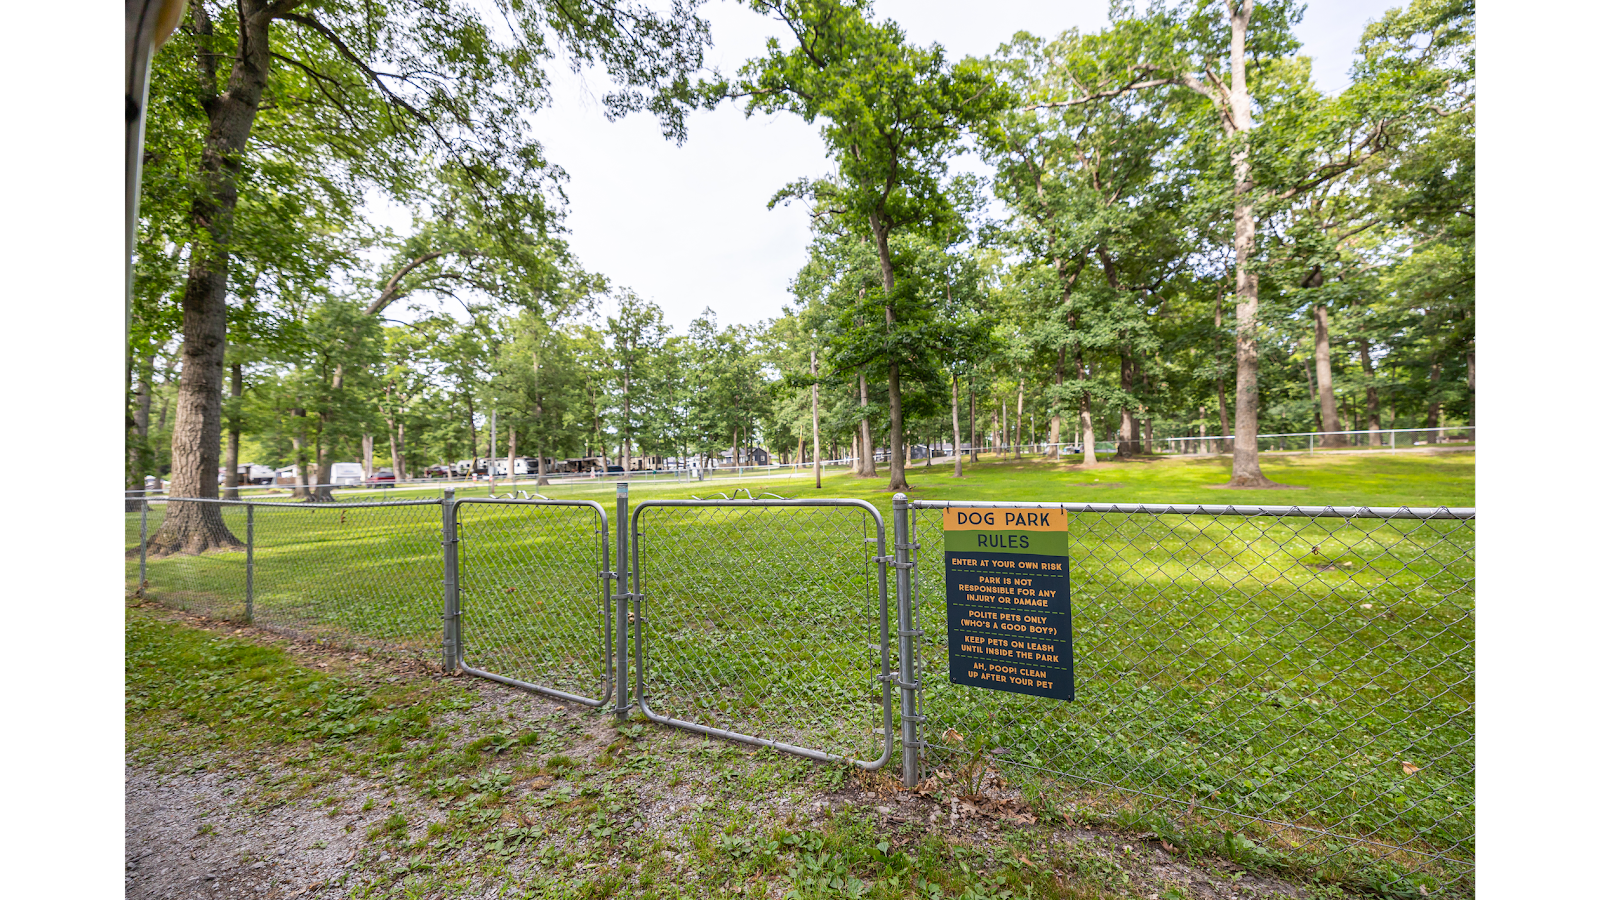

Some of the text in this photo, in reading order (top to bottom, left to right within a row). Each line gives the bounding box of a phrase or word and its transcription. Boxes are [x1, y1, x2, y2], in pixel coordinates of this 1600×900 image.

[958, 512, 1050, 526] DOG PARK
[977, 534, 1030, 549] RULES
[952, 558, 978, 566] ENTER
[992, 560, 1015, 568] YOUR
[1018, 561, 1038, 569] OWN
[1041, 562, 1062, 570] RISK
[979, 576, 1000, 584] PARK
[1014, 578, 1032, 586] NOT
[959, 584, 1056, 598] RESPONSIBLE FOR ANY
[966, 594, 1048, 607] INJURY OR DAMAGE
[969, 610, 1047, 624] POLITE PETS ONLY
[961, 618, 990, 628] (WHO'S
[1001, 623, 1027, 632] GOOD
[1029, 625, 1057, 636] BOY?)
[964, 635, 1054, 652] KEEP PETS ON LEASH
[961, 644, 1059, 662] UNTIL INSIDE THE PARK
[973, 662, 1046, 678] AH, POOP! CLEAN
[981, 672, 1007, 683] AFTER
[1009, 676, 1033, 686] YOUR
[1036, 680, 1053, 689] PET
